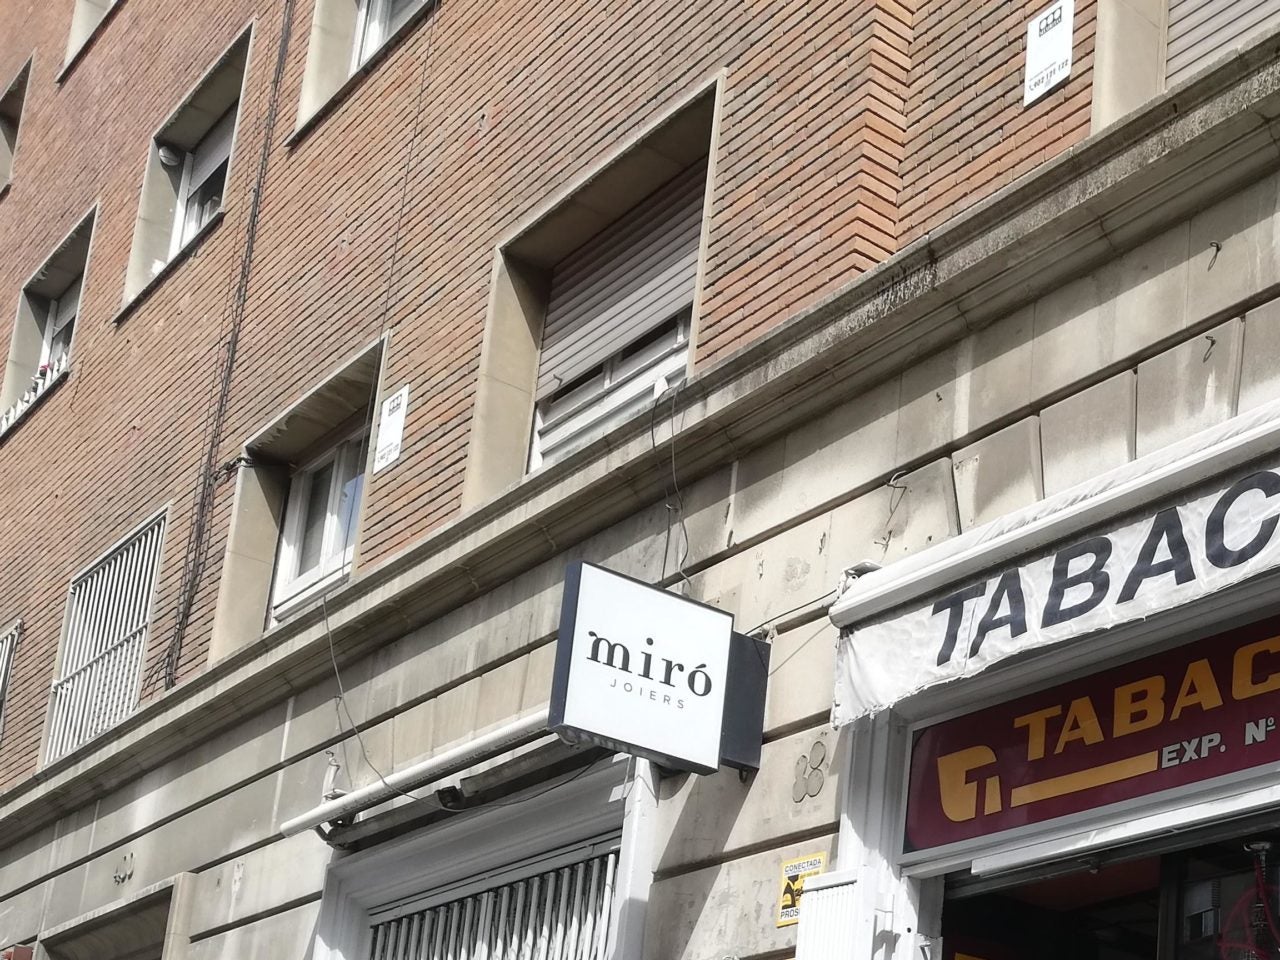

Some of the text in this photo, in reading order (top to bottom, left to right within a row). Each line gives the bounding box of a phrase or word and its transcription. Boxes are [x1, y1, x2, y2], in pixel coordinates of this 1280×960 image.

[586, 630, 712, 697] miró
[610, 678, 685, 709] JOIERS
[1161, 732, 1226, 769] EXP.
[784, 857, 822, 873] CONECTADA
[780, 907, 800, 919] PROS
